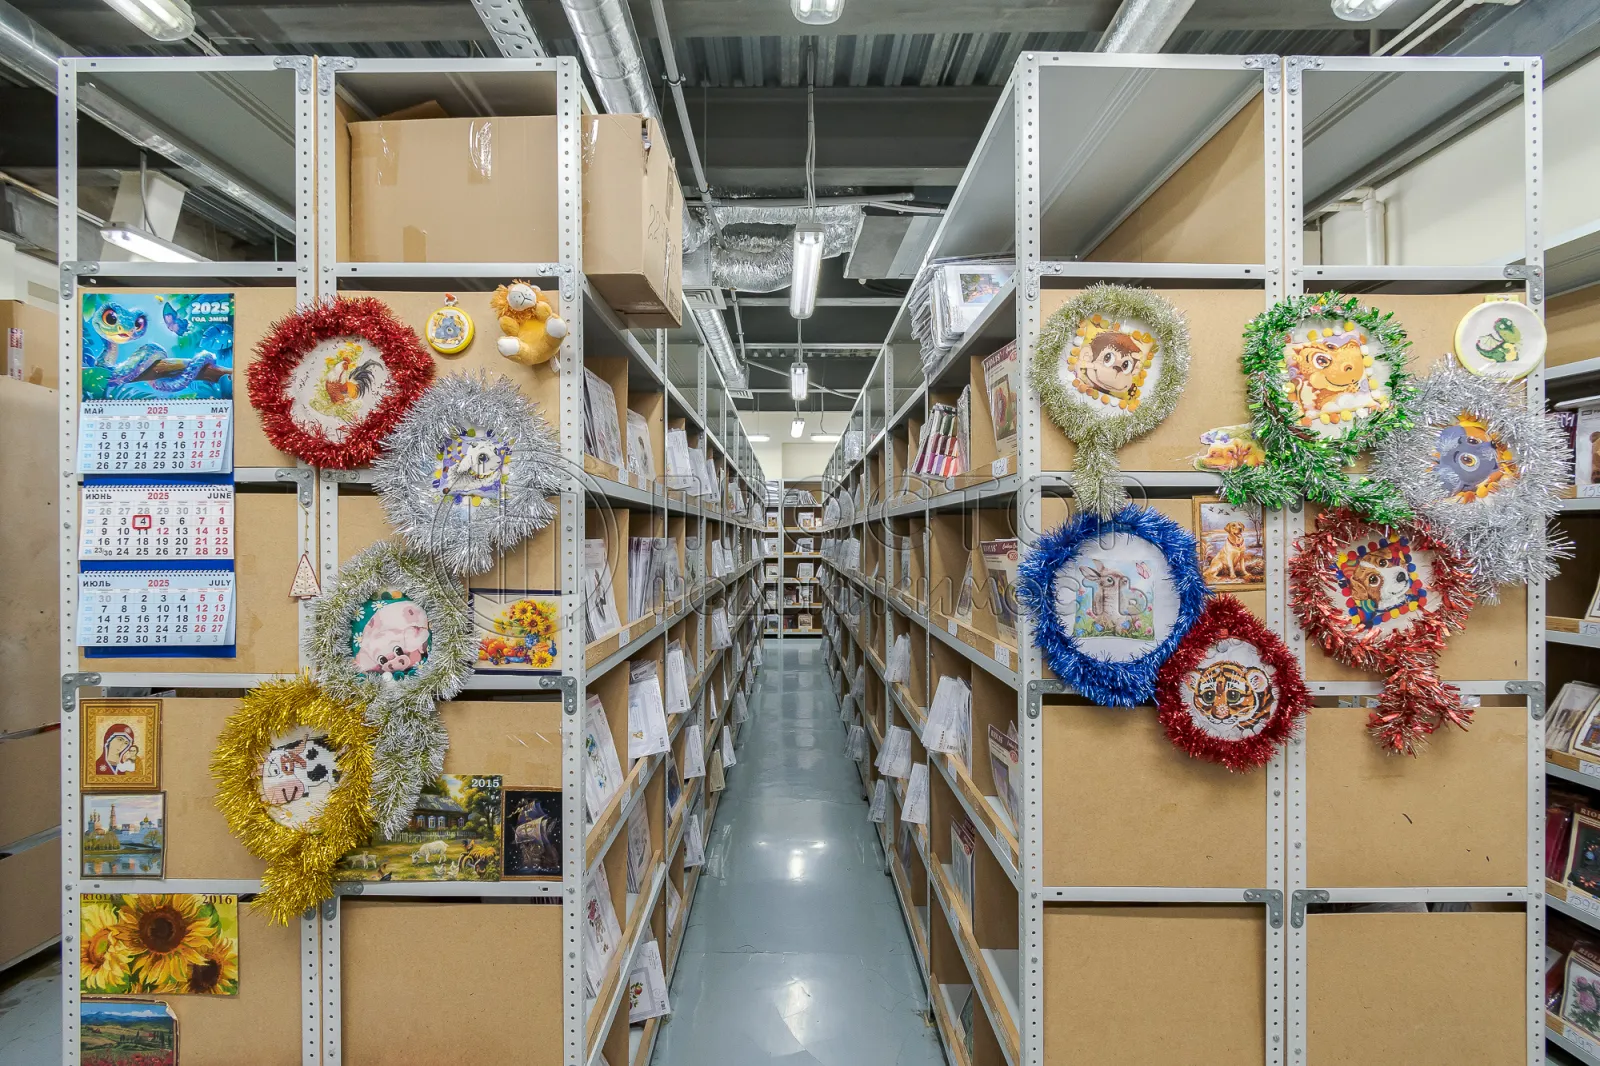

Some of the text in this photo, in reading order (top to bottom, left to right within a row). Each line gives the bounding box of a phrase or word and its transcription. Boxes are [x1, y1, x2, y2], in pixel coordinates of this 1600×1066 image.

[191, 302, 230, 314] 2025
[472, 778, 500, 788] 2015
[202, 894, 232, 905] 2016
